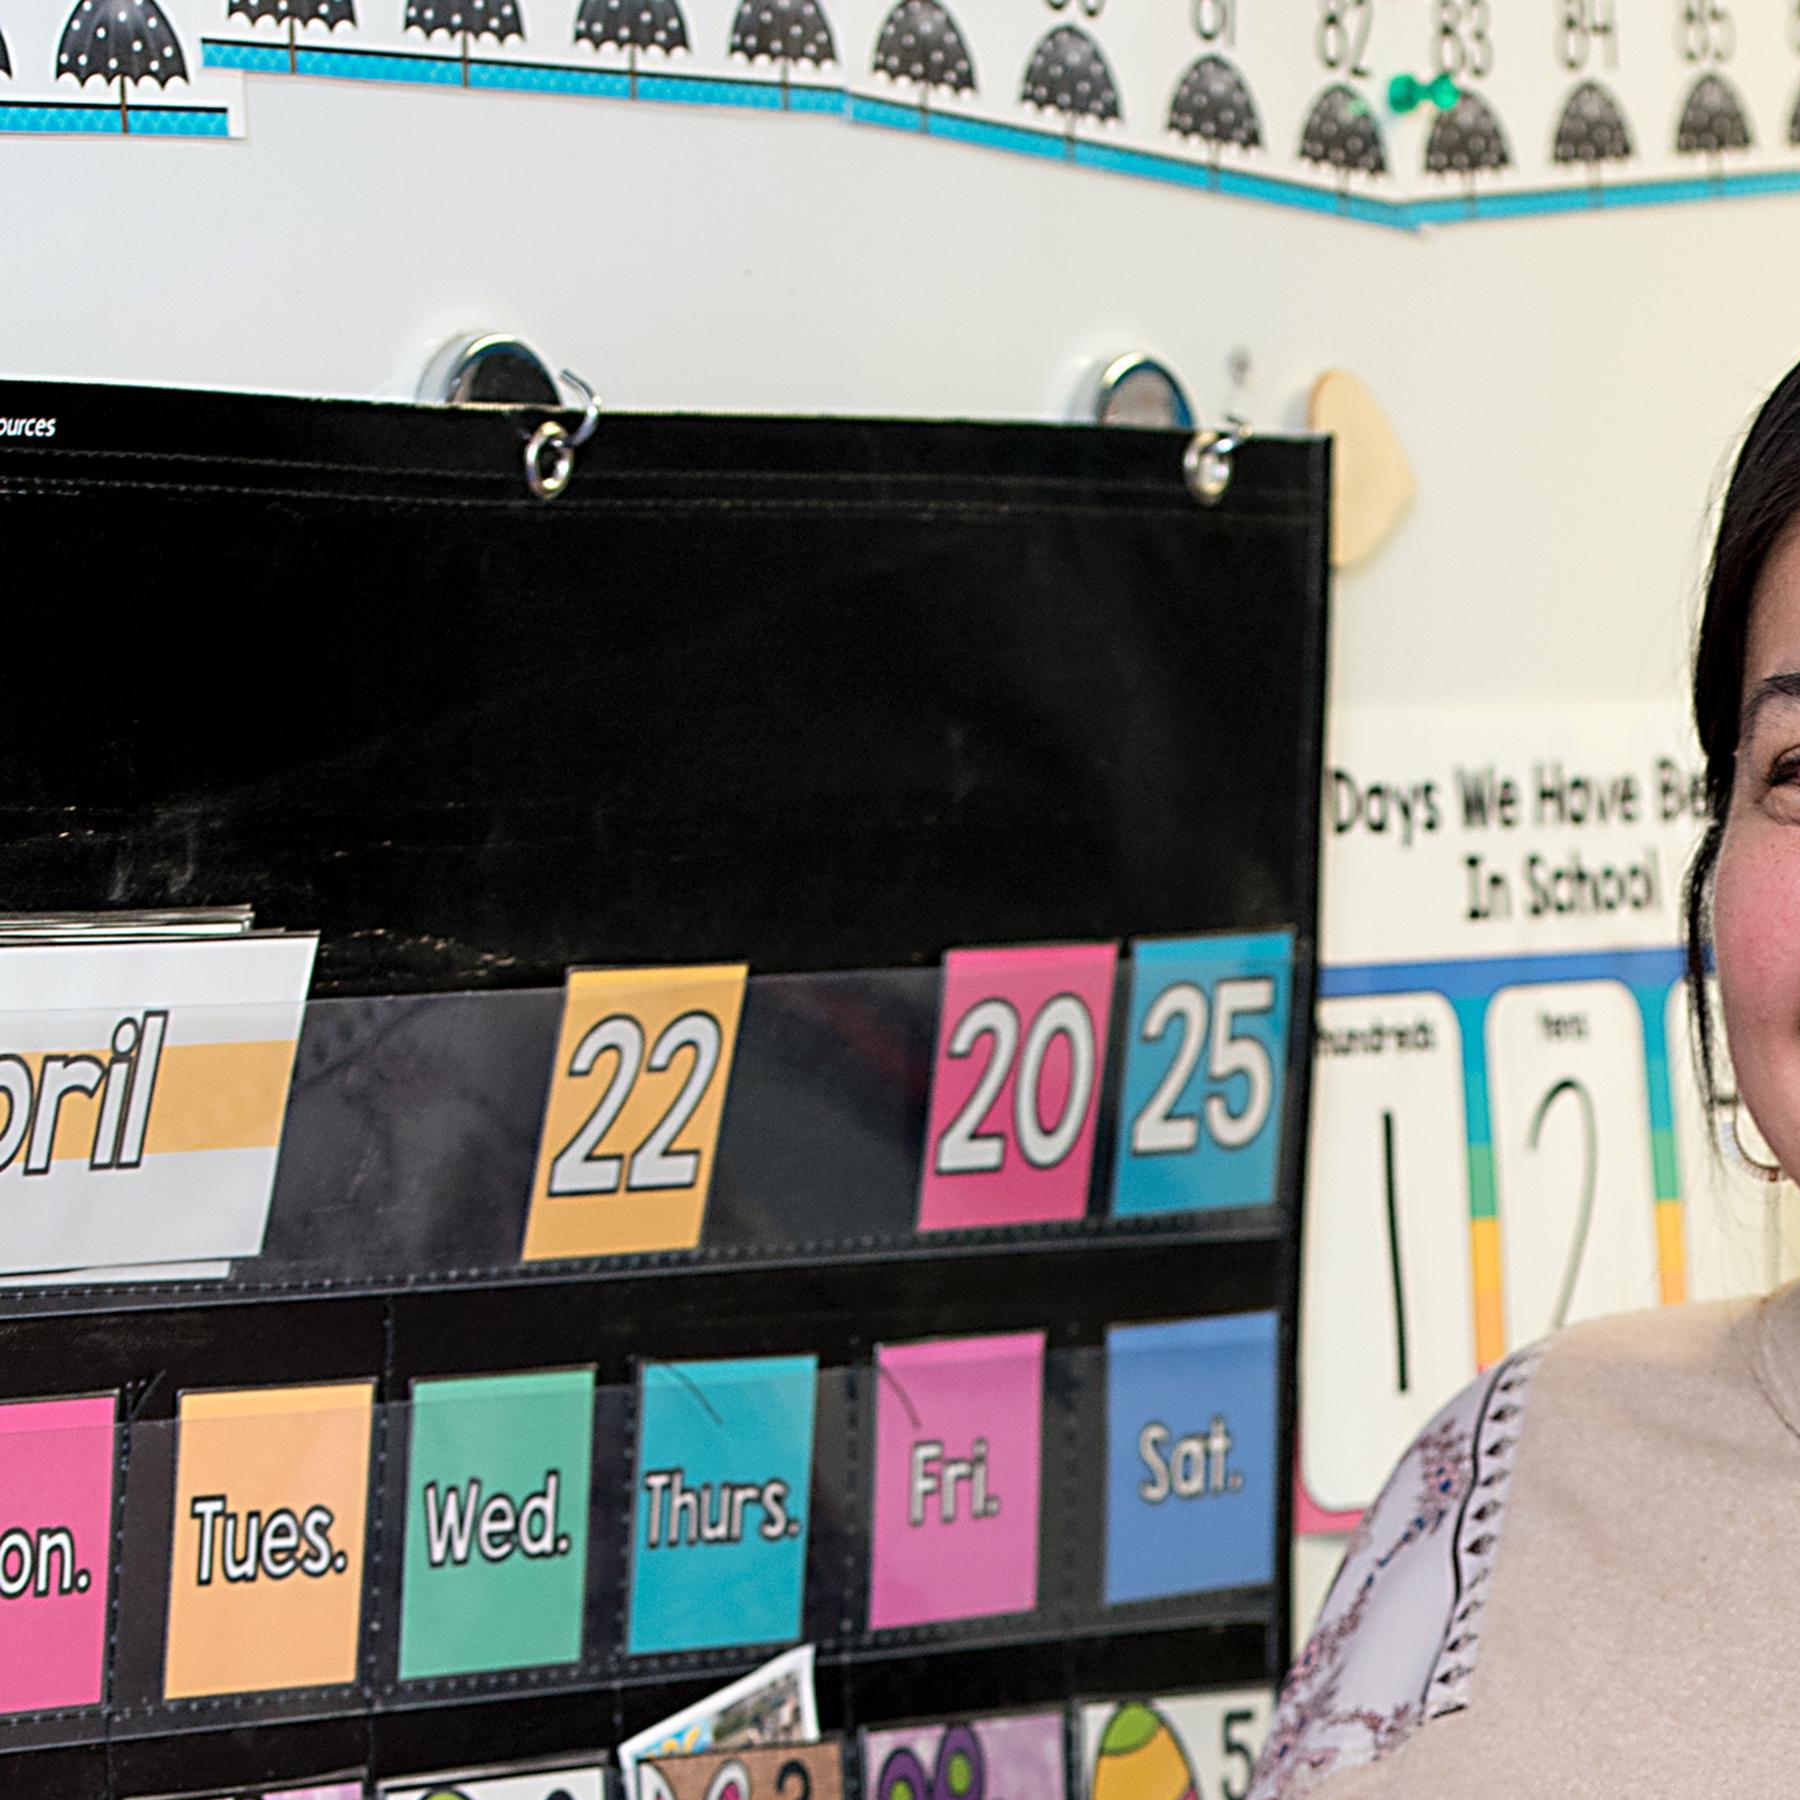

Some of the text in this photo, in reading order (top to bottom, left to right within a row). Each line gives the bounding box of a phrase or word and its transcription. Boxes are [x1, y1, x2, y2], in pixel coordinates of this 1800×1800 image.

[1332, 768, 1442, 848] Days
[1455, 764, 1519, 830] We
[1534, 762, 1640, 825] Have
[1466, 849, 1662, 921] In School
[548, 1010, 722, 1197] 22
[936, 993, 1095, 1175] 20
[1132, 977, 1275, 1155] 25
[191, 1494, 348, 1586] Tues.
[425, 1469, 571, 1568] Wed.
[645, 1466, 800, 1549] Thurs.
[909, 1436, 1000, 1528] Fri.
[1138, 1414, 1244, 1504] Sat.
